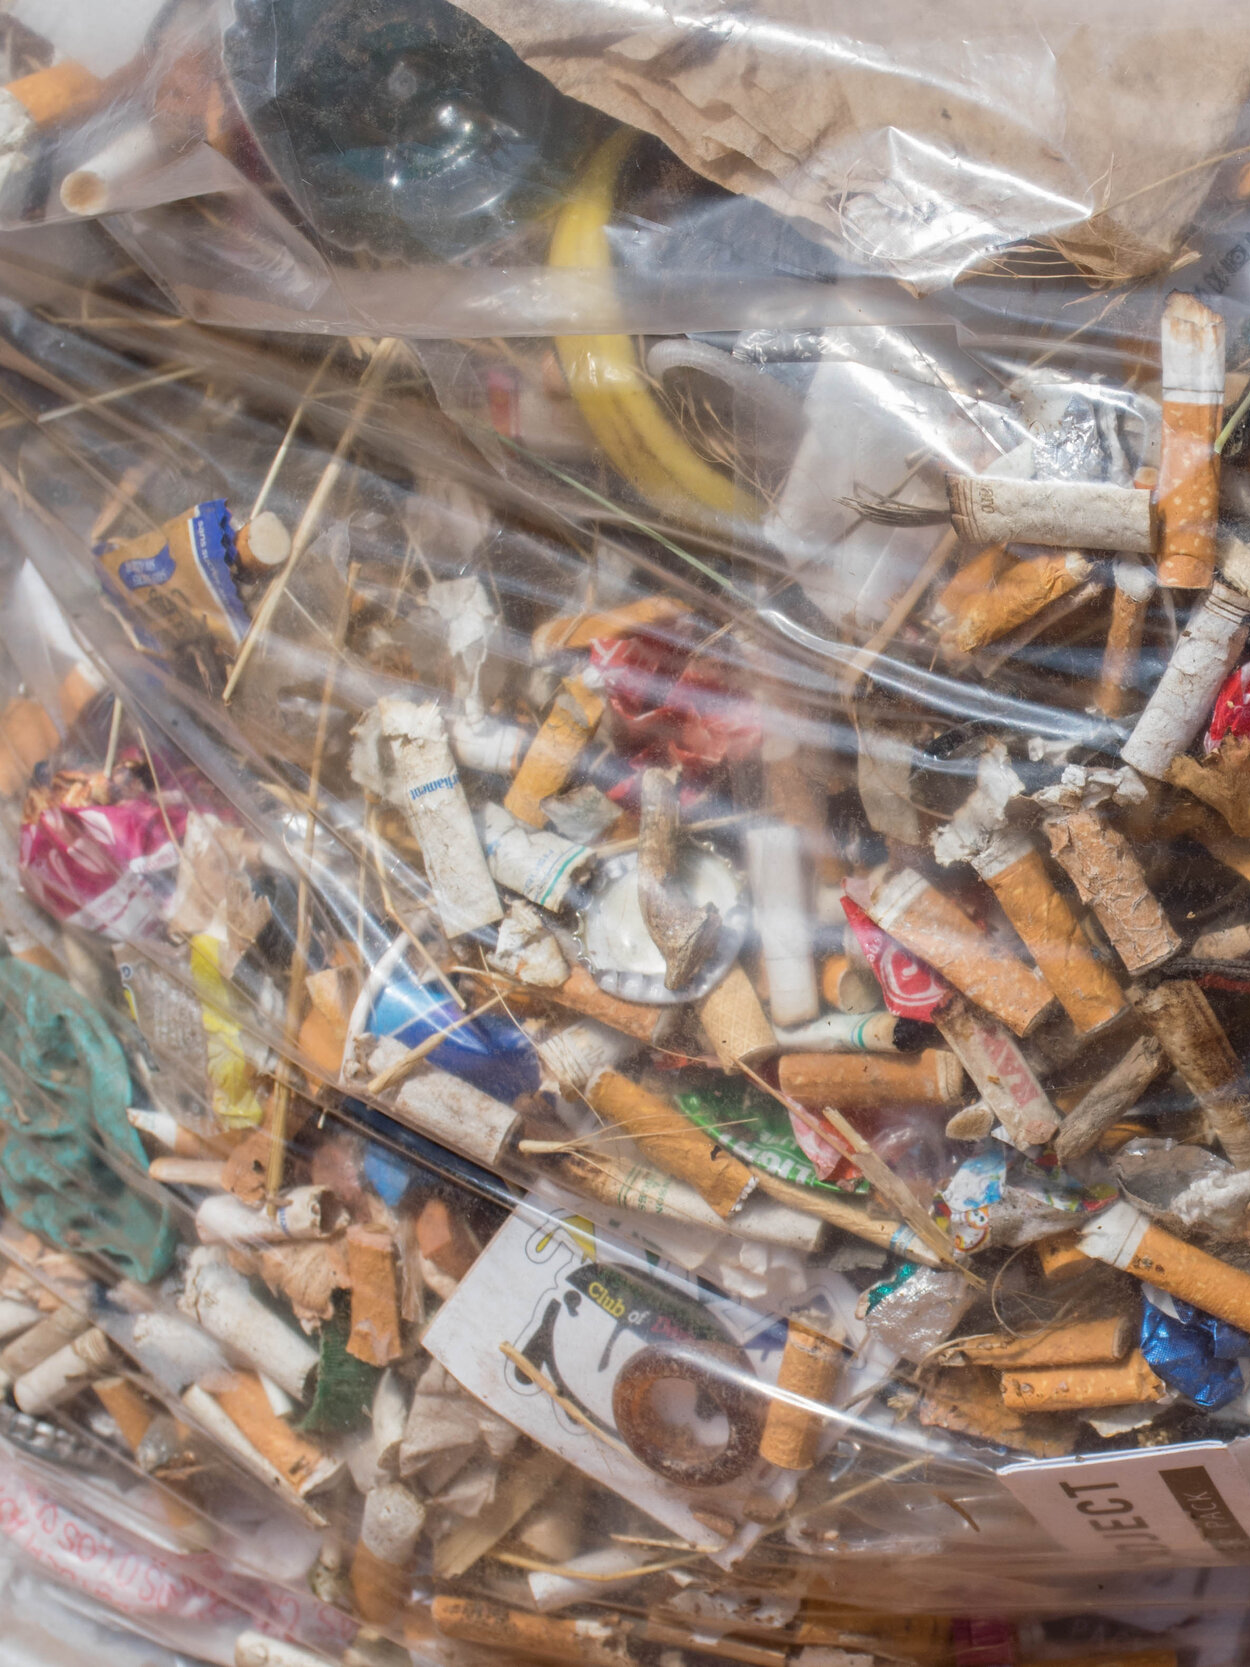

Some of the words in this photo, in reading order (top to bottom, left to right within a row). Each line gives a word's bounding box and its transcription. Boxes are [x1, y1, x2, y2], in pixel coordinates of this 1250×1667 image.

[588, 1282, 627, 1318] Club
[628, 1310, 650, 1325] of
[1185, 1490, 1227, 1527] PACK
